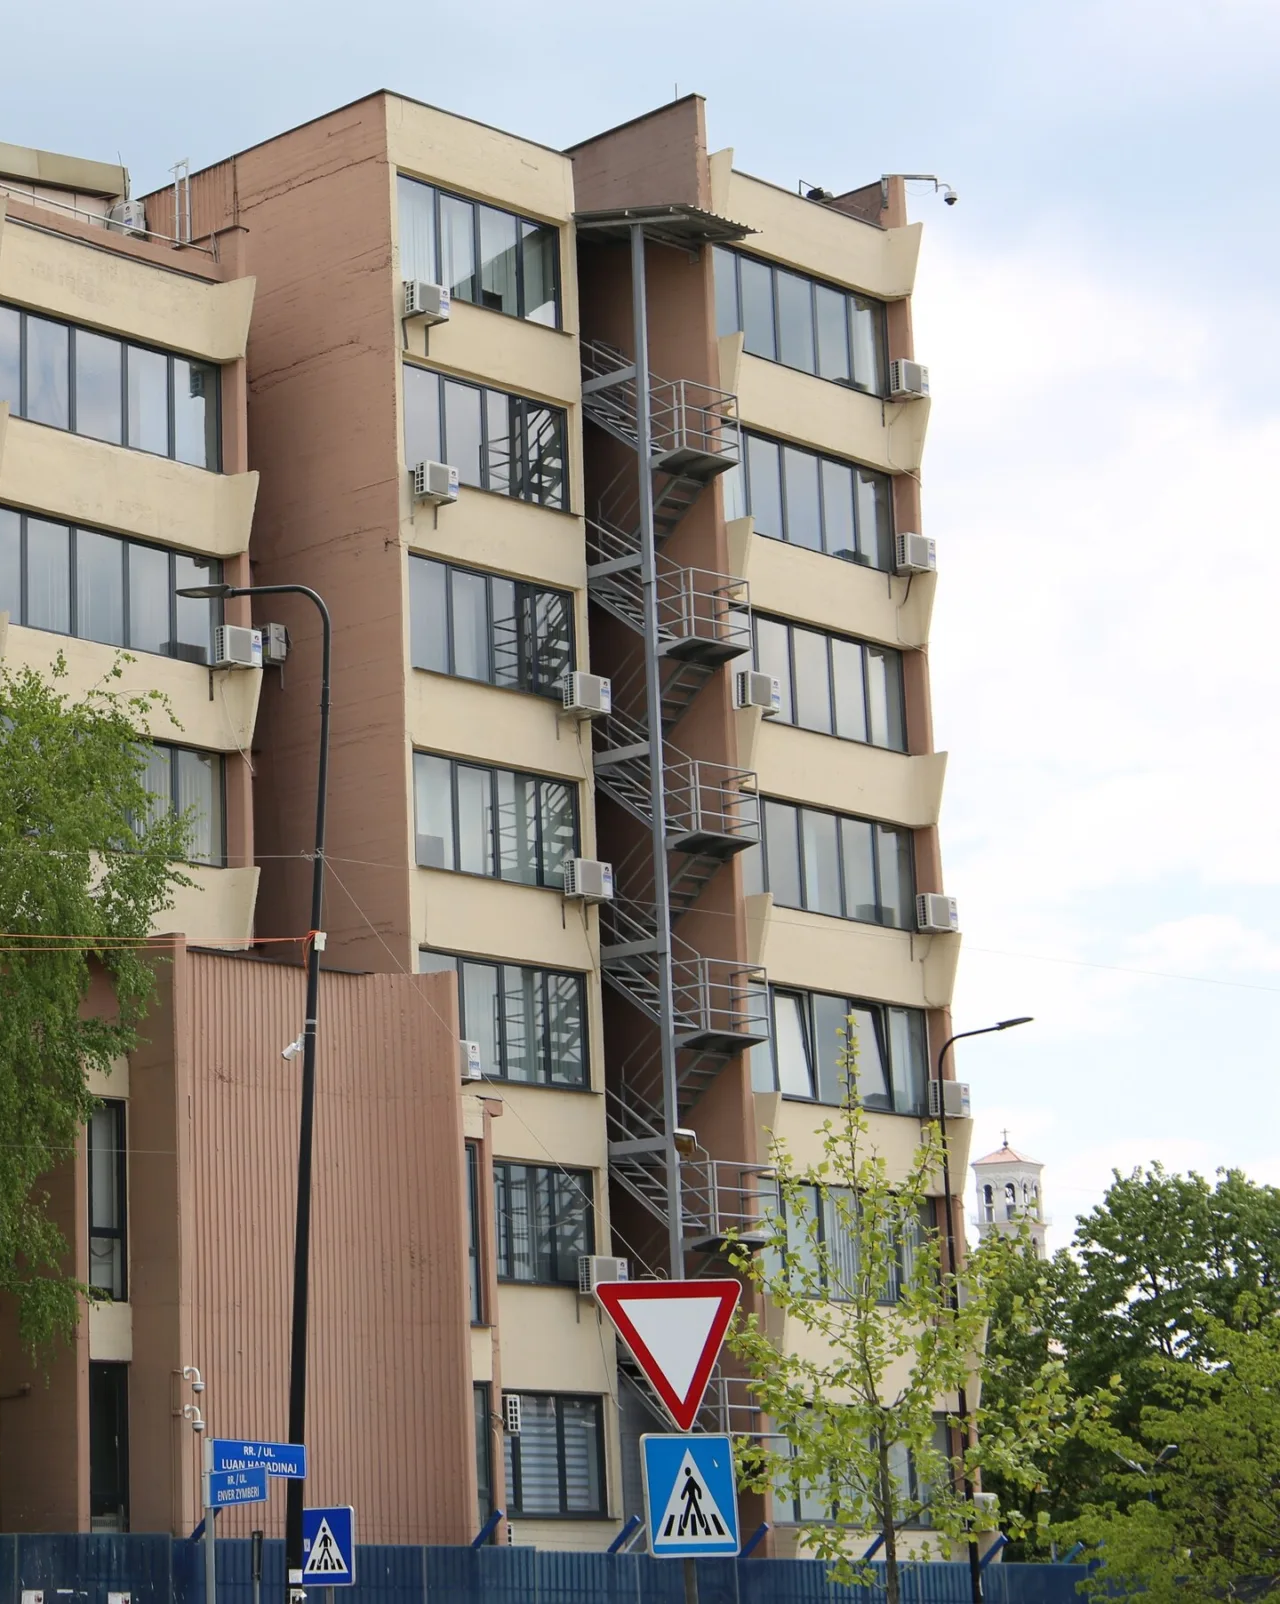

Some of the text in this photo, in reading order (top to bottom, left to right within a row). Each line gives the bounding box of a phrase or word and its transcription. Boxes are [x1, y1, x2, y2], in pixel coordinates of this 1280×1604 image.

[243, 1446, 276, 1458] RR. / UL.
[221, 1458, 246, 1469] LUAN
[227, 1475, 235, 1485] RR.
[239, 1474, 247, 1484] UL.
[218, 1486, 260, 1501] ENVER ZYMBERI
